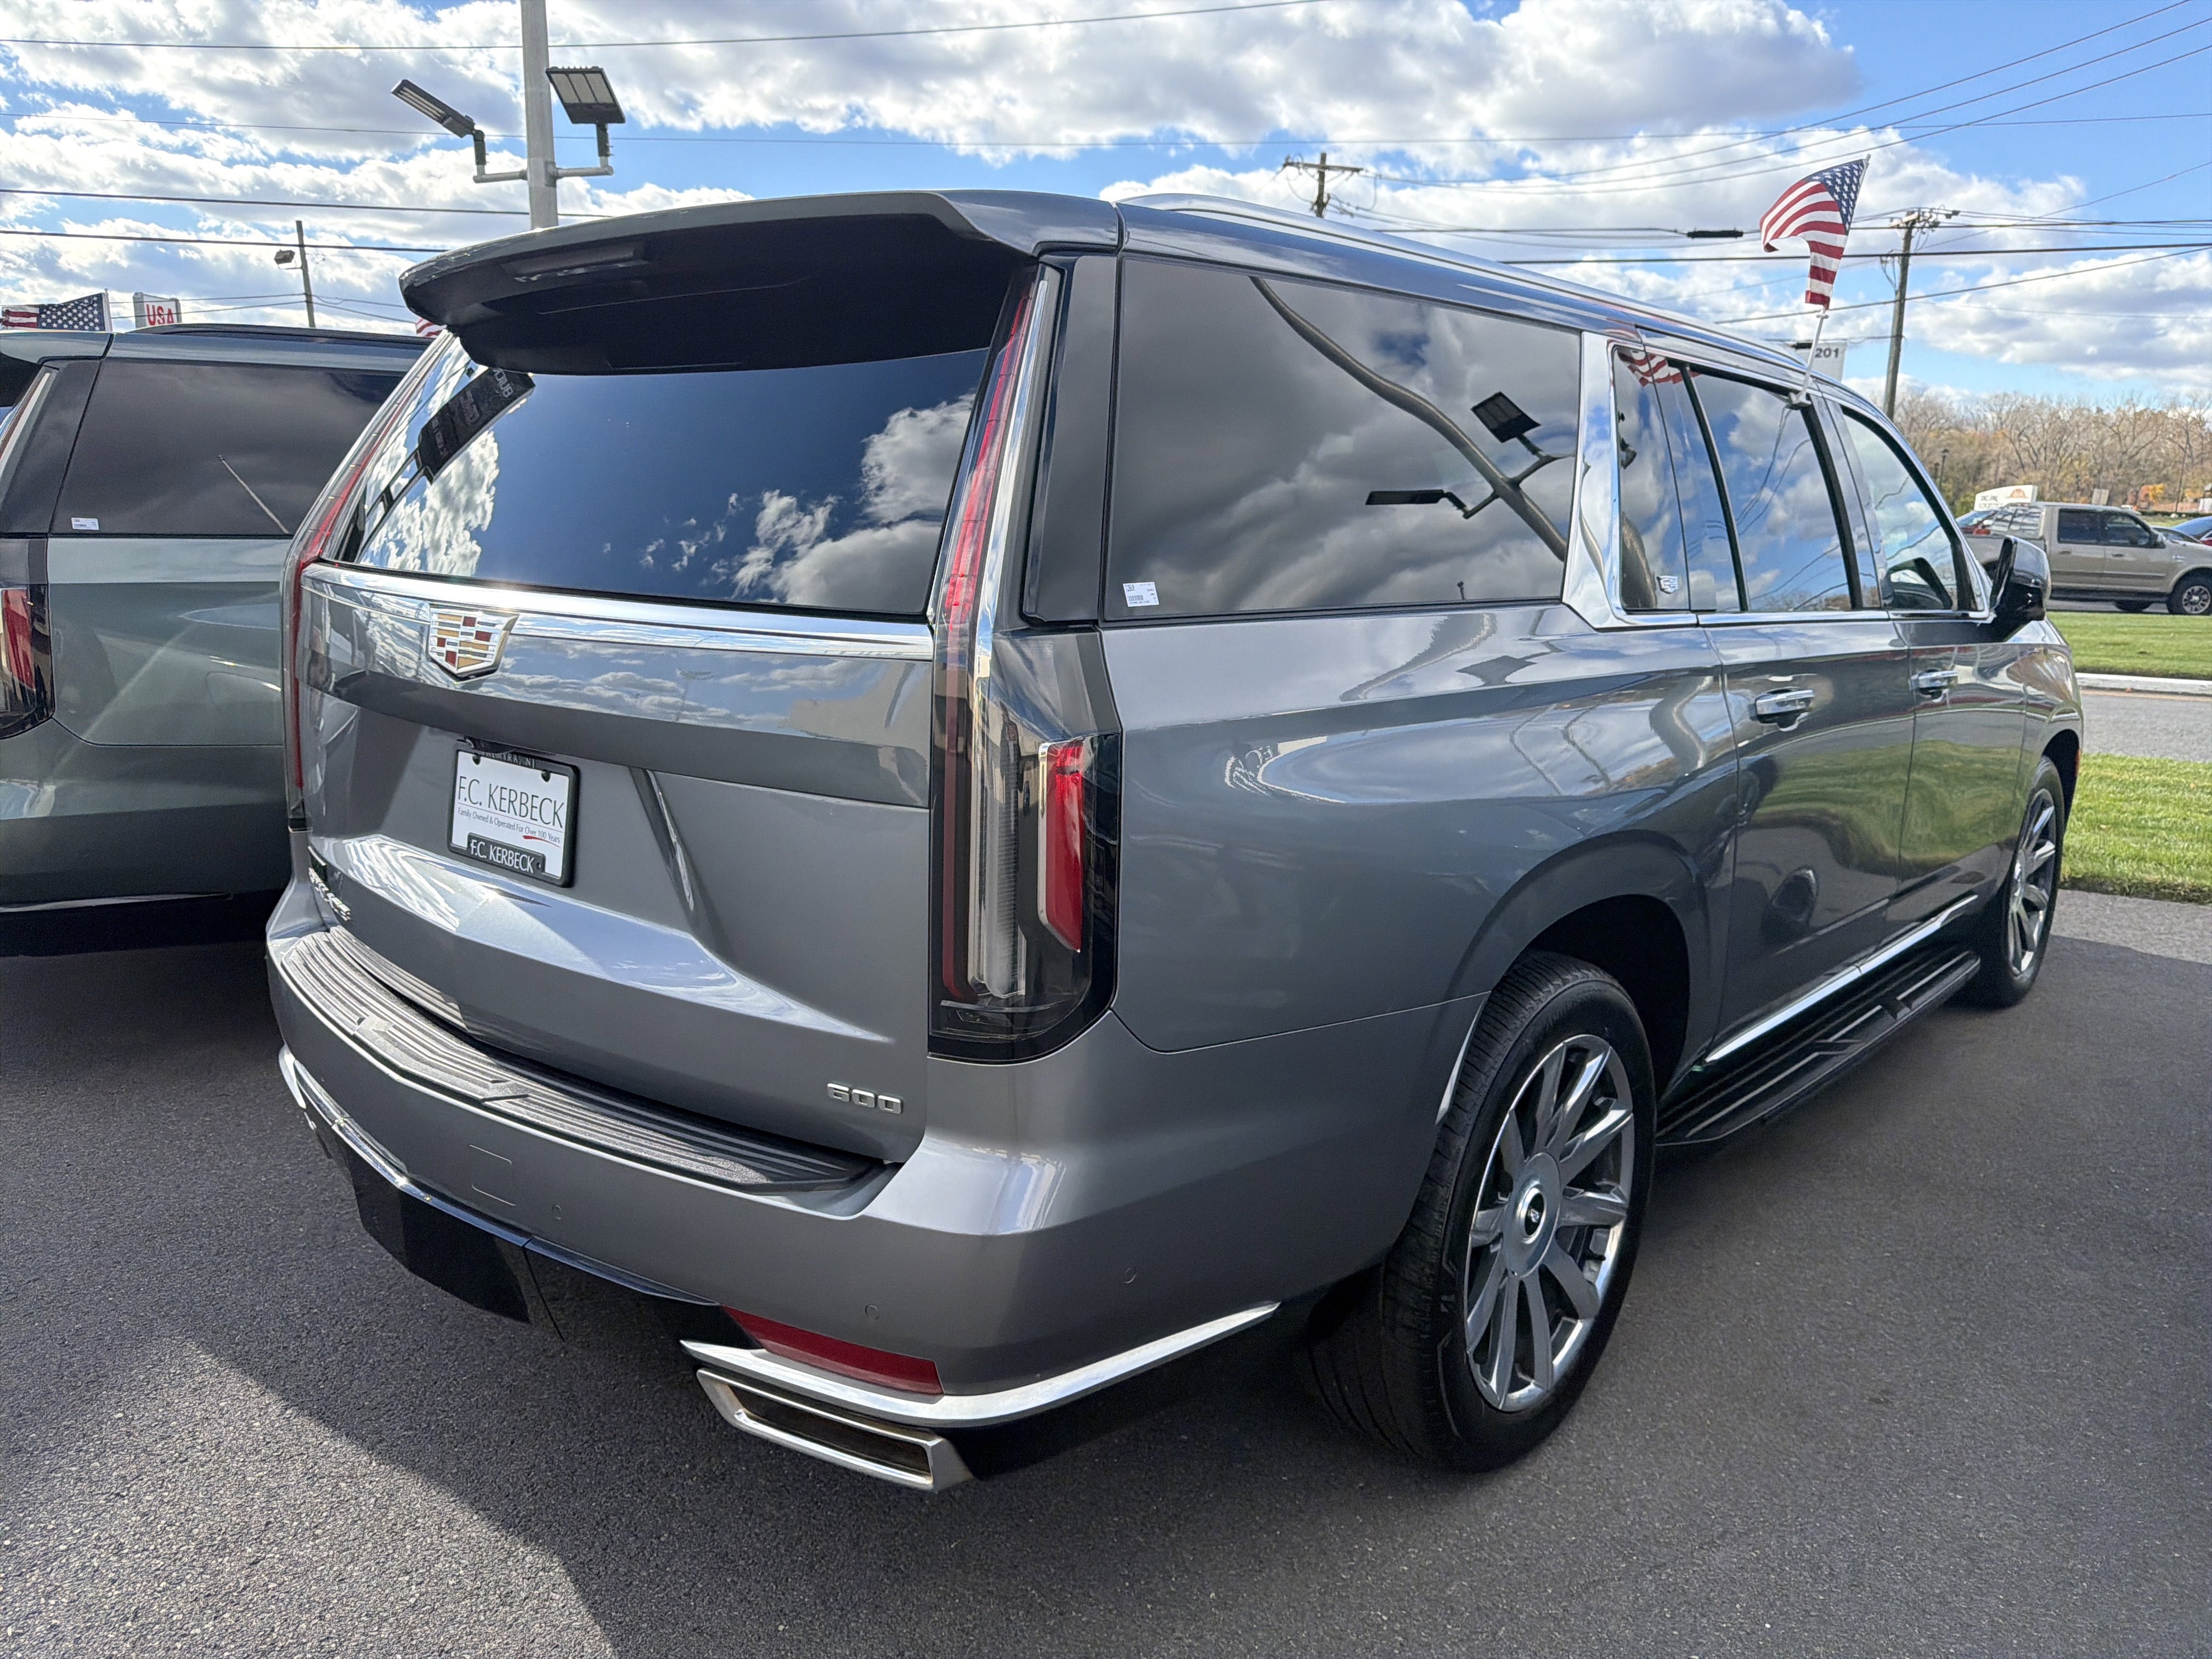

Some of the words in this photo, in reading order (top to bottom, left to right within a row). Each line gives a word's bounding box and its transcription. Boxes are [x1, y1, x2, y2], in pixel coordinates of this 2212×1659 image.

[146, 304, 174, 325] USA
[1815, 347, 1838, 358] 201
[458, 776, 482, 806] F.C.
[488, 783, 565, 828] KERBECK
[458, 807, 472, 819] Family
[472, 812, 488, 822] Owned
[494, 818, 515, 830] Operated
[525, 827, 537, 836] Over
[538, 830, 546, 838] 100
[548, 832, 560, 843] Years
[471, 839, 487, 859] F.C.
[489, 844, 535, 873] KERBECK
[827, 1082, 903, 1114] 600
